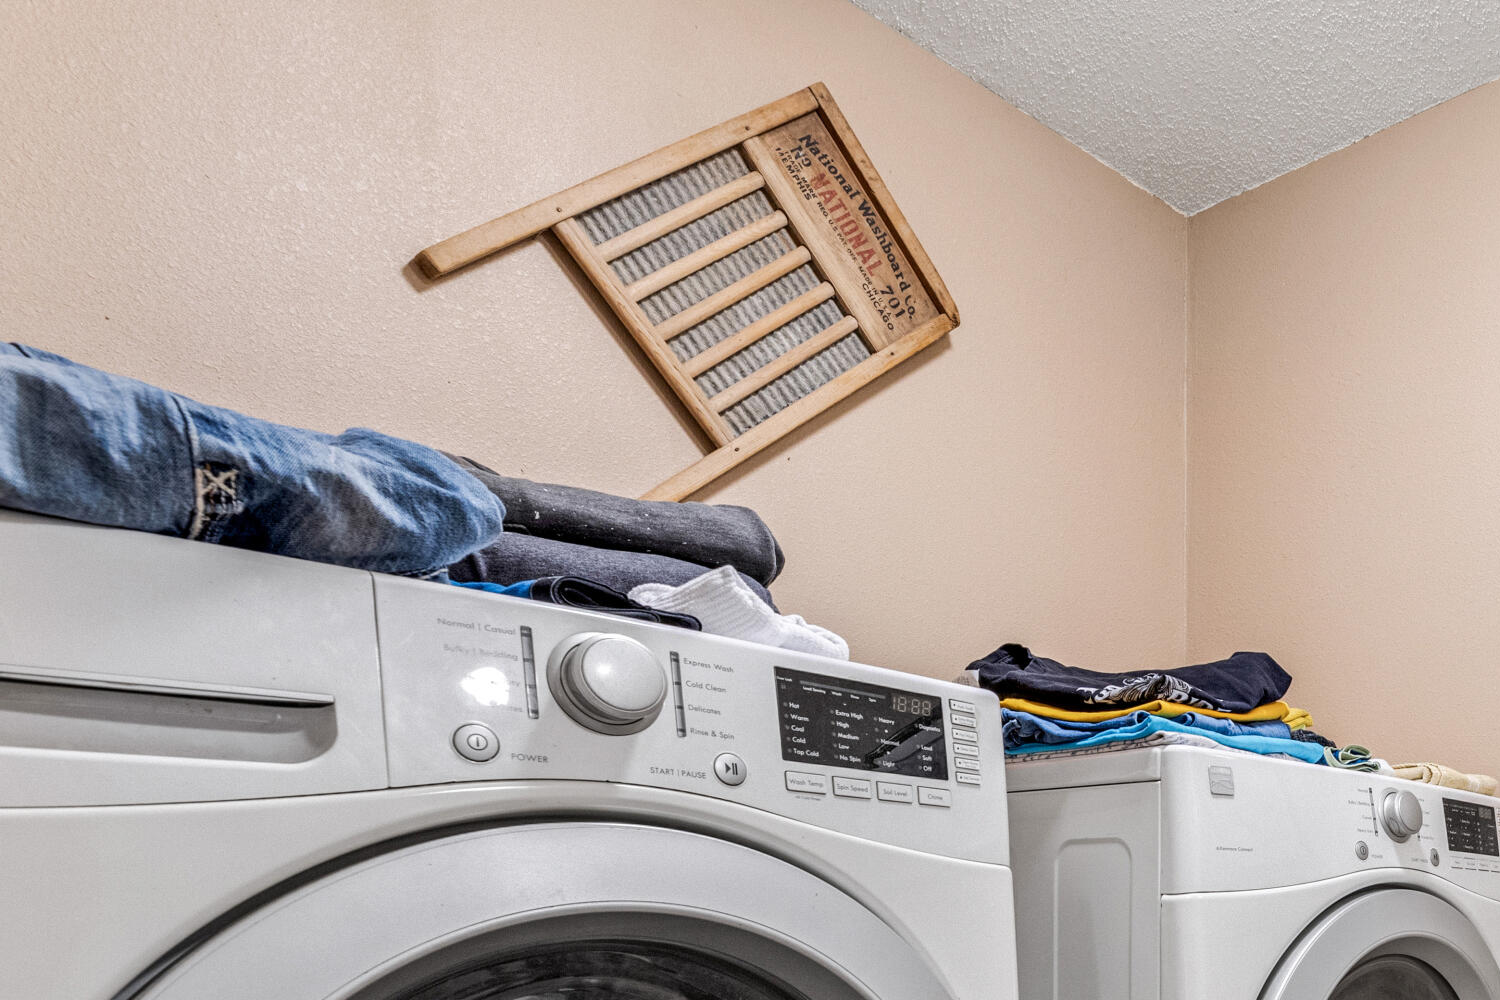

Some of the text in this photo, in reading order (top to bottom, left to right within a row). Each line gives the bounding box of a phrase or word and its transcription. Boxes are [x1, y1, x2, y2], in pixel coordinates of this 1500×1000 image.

[776, 147, 812, 201] MEMPHIS
[798, 134, 861, 200] National
[858, 199, 911, 293] Washboard
[801, 176, 818, 199] MARK
[858, 265, 873, 286] MADE
[811, 172, 883, 278] NATIONAL
[862, 283, 894, 331] CHICAGO
[880, 285, 906, 319] 701
[437, 617, 516, 636] Normal Casual
[683, 657, 734, 673] Express Wash
[685, 680, 728, 694] Cold Clean
[687, 704, 722, 716] Delicates
[788, 701, 800, 709] Hot
[790, 713, 810, 722] Warm
[835, 709, 864, 720] Extra High
[836, 720, 850, 729] High
[690, 727, 709, 737] Rinse
[719, 731, 735, 741] Spin
[791, 736, 807, 744] Cold
[837, 732, 860, 741] Medium
[511, 752, 549, 763] POWER
[805, 749, 820, 757] Cold
[650, 766, 707, 780] START PAUSE
[789, 777, 824, 788] Wash Temp
[850, 785, 869, 793] Speed
